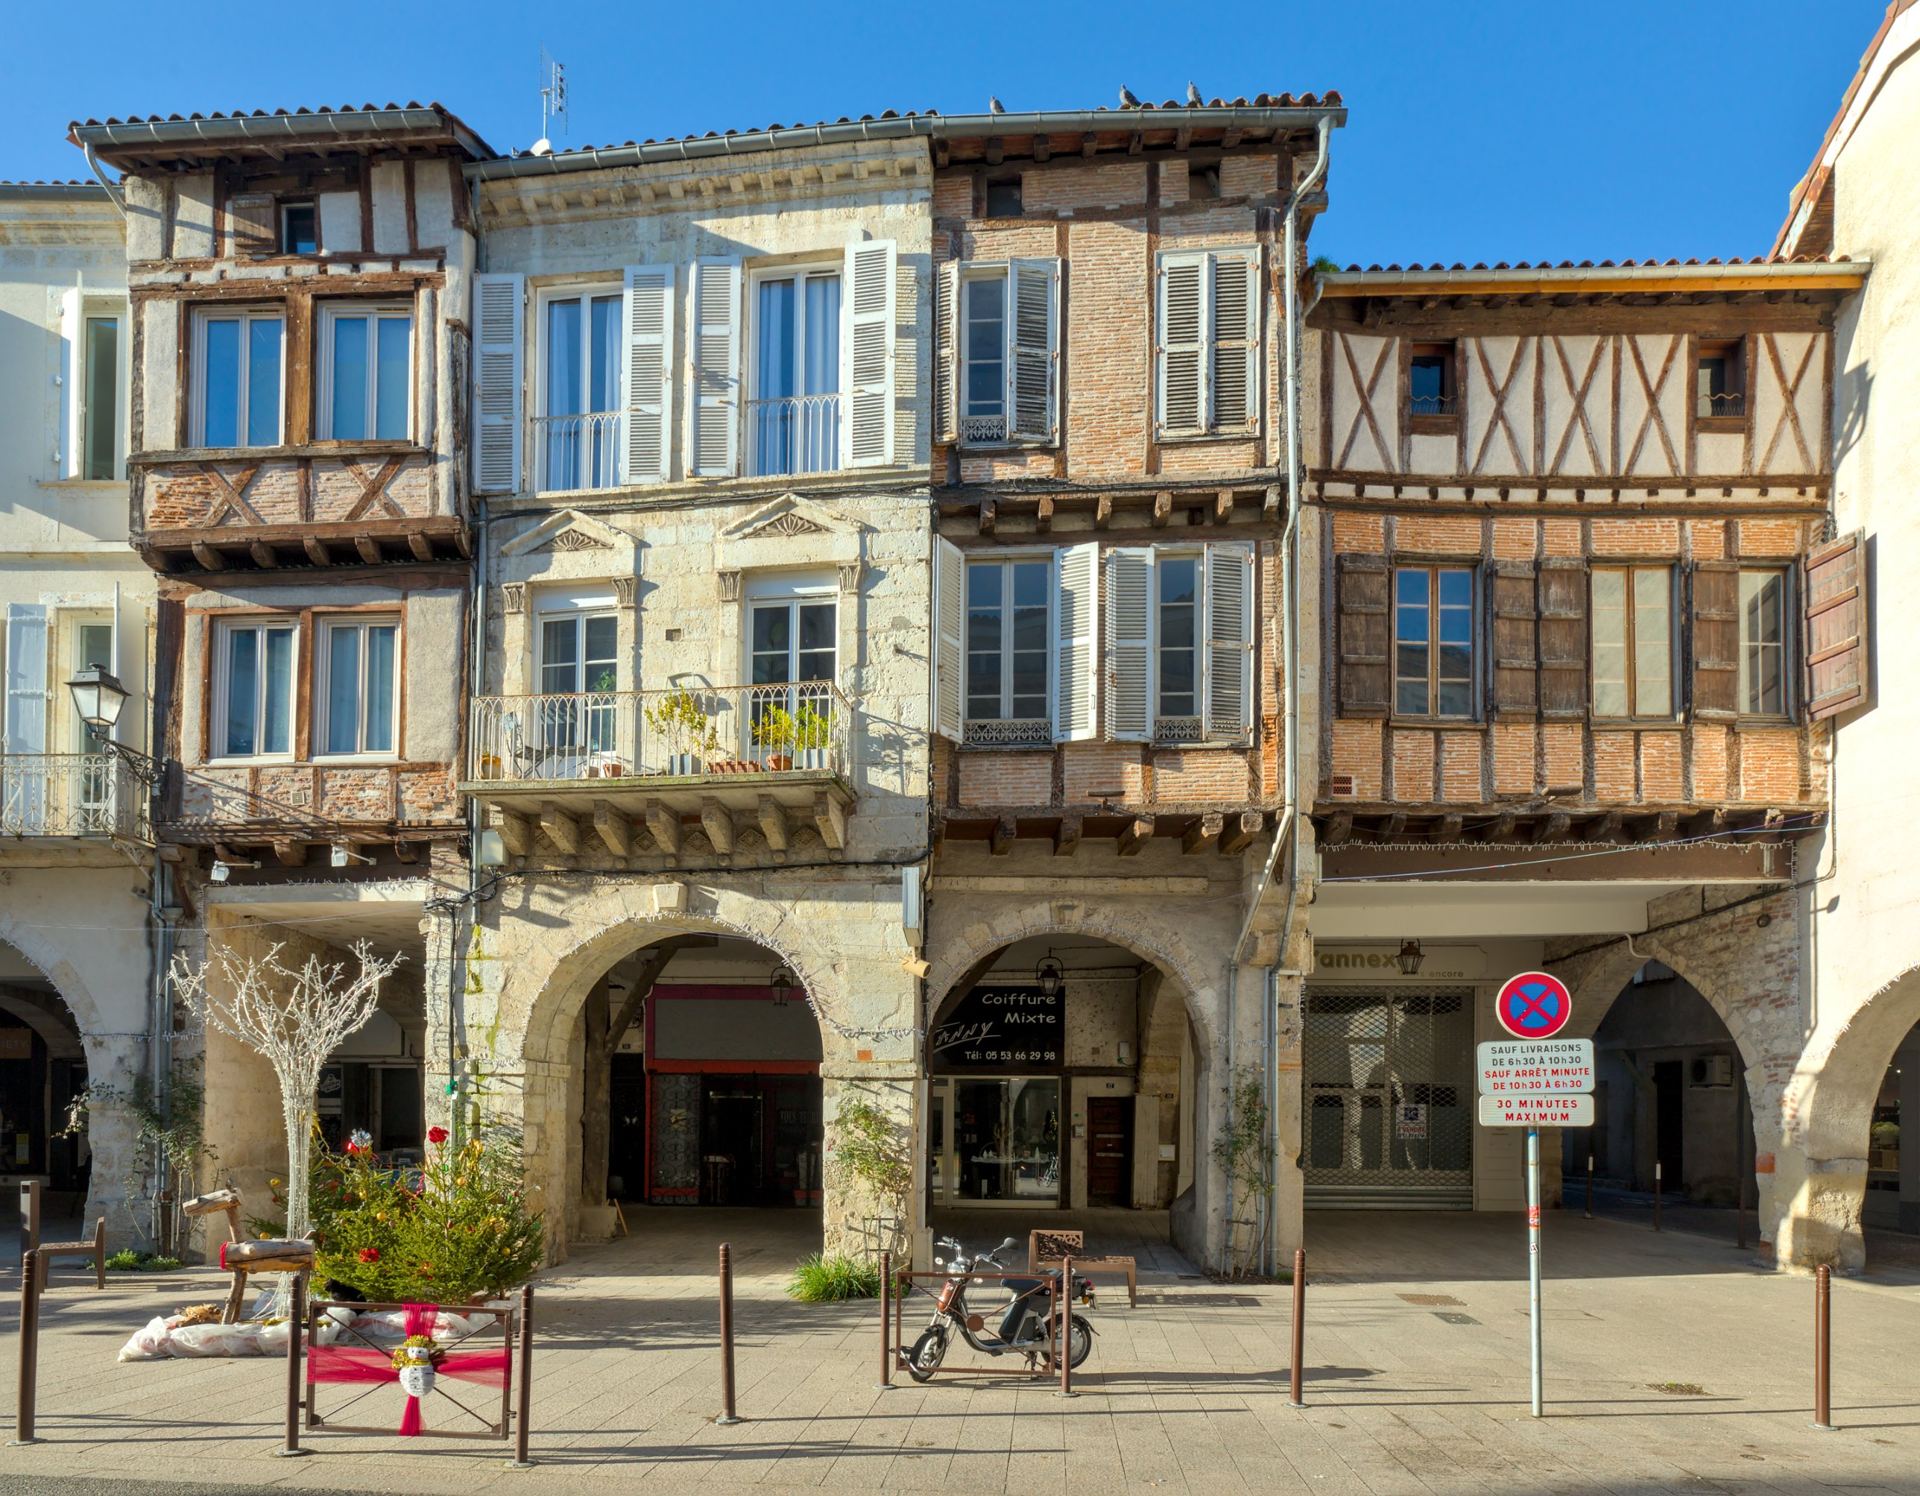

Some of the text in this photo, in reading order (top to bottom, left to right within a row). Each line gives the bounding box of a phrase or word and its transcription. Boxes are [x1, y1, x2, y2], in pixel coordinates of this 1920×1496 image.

[982, 993, 1056, 1005] Coiffure
[1004, 1012, 1056, 1024] Mixte
[1491, 1044, 1582, 1054] SAUF LIVRAISONS
[965, 1051, 1056, 1060] Tél: 05 53 66 29 98
[1492, 1056, 1581, 1066] DE 6h30 À 10h30
[1485, 1068, 1589, 1078] SAUF ARRÊT MINUTE
[1493, 1082, 1505, 1090] DE
[1545, 1079, 1551, 1088] À
[1555, 1080, 1582, 1088] 6h30
[1497, 1100, 1578, 1108] 30 MINUTES
[1505, 1113, 1569, 1121] MAXIMUM
